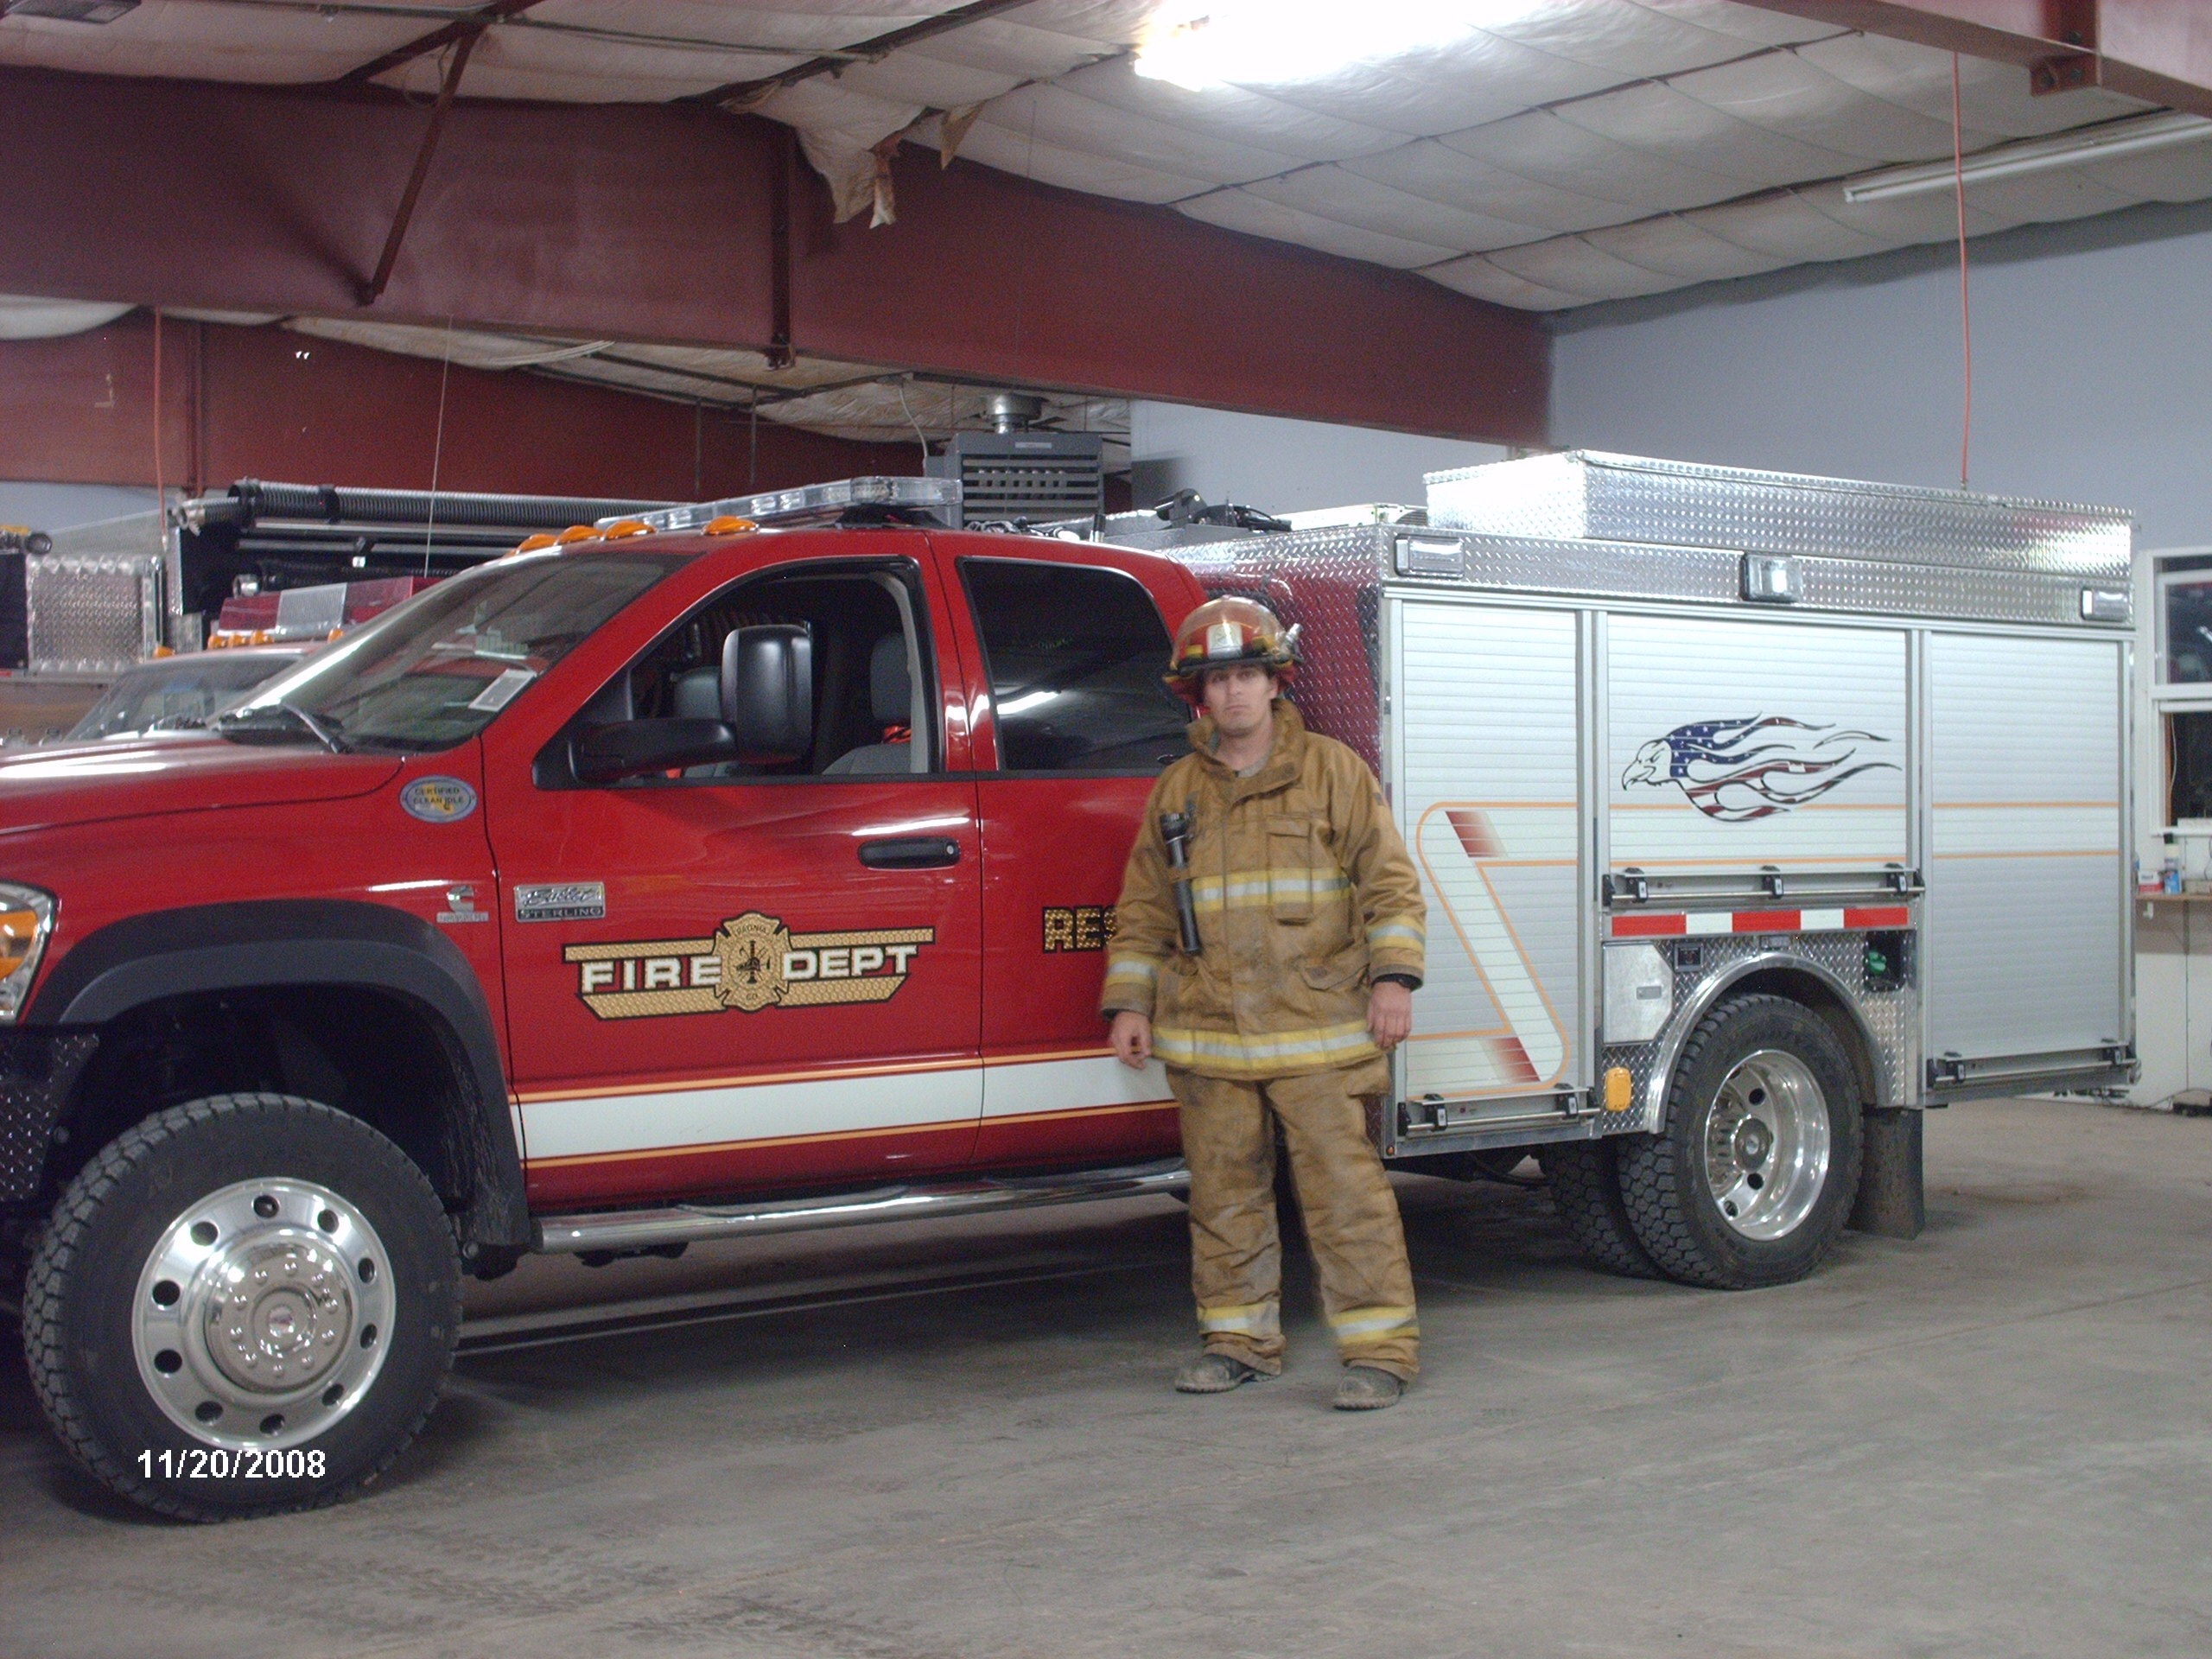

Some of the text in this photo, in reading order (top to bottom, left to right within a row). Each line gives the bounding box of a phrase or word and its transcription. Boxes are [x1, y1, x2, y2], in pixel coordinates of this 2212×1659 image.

[415, 785, 461, 795] CERTIFIED
[519, 906, 602, 919] STERLING
[581, 944, 918, 995] FIRE DEPT
